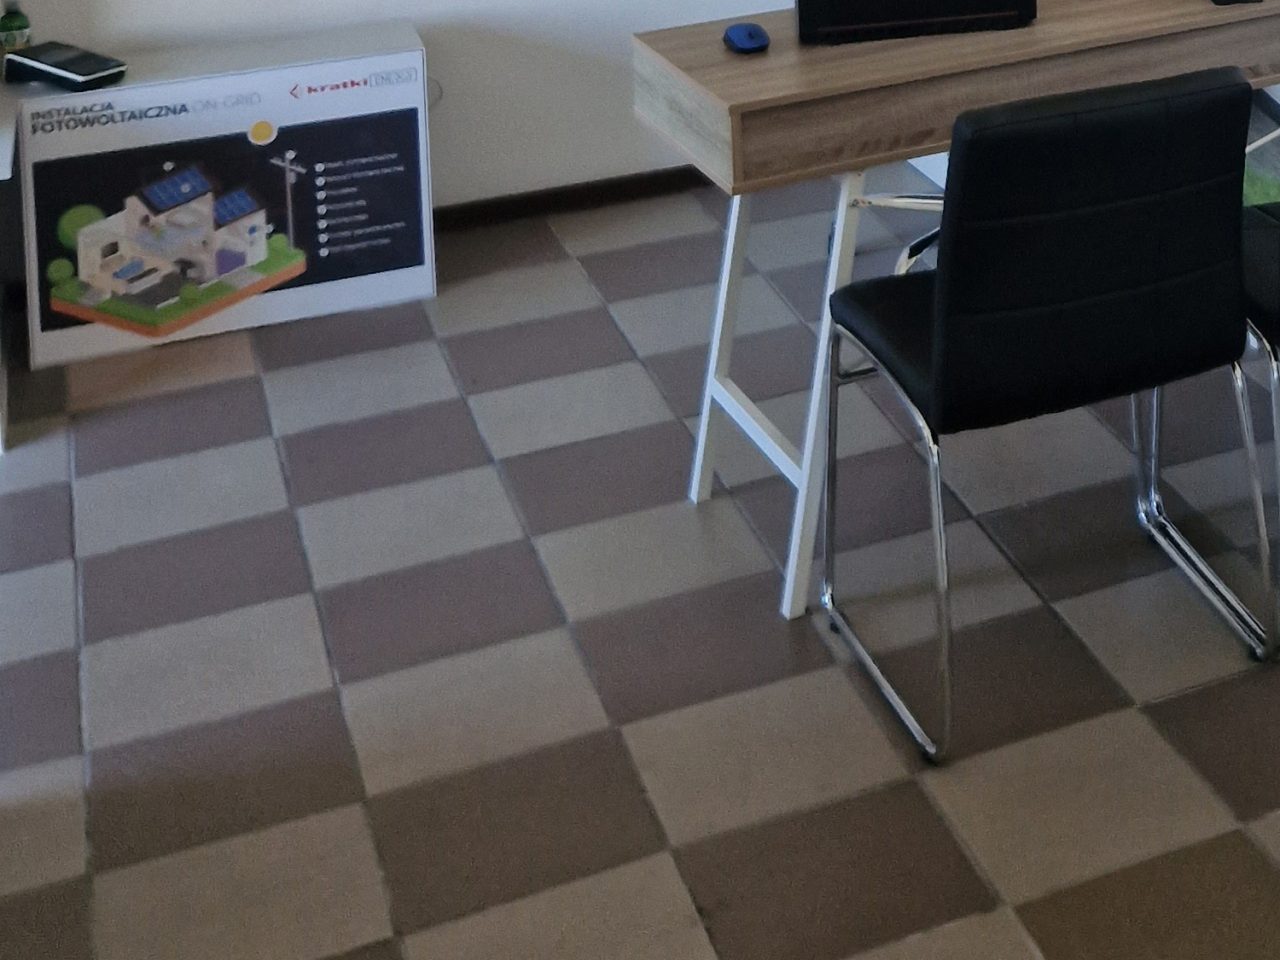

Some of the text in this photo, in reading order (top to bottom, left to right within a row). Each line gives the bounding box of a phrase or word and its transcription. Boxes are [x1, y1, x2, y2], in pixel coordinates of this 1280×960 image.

[306, 78, 368, 95] kratki
[29, 101, 114, 122] INSTALACJA
[30, 102, 190, 136] FOTOWOLTAICZNA
